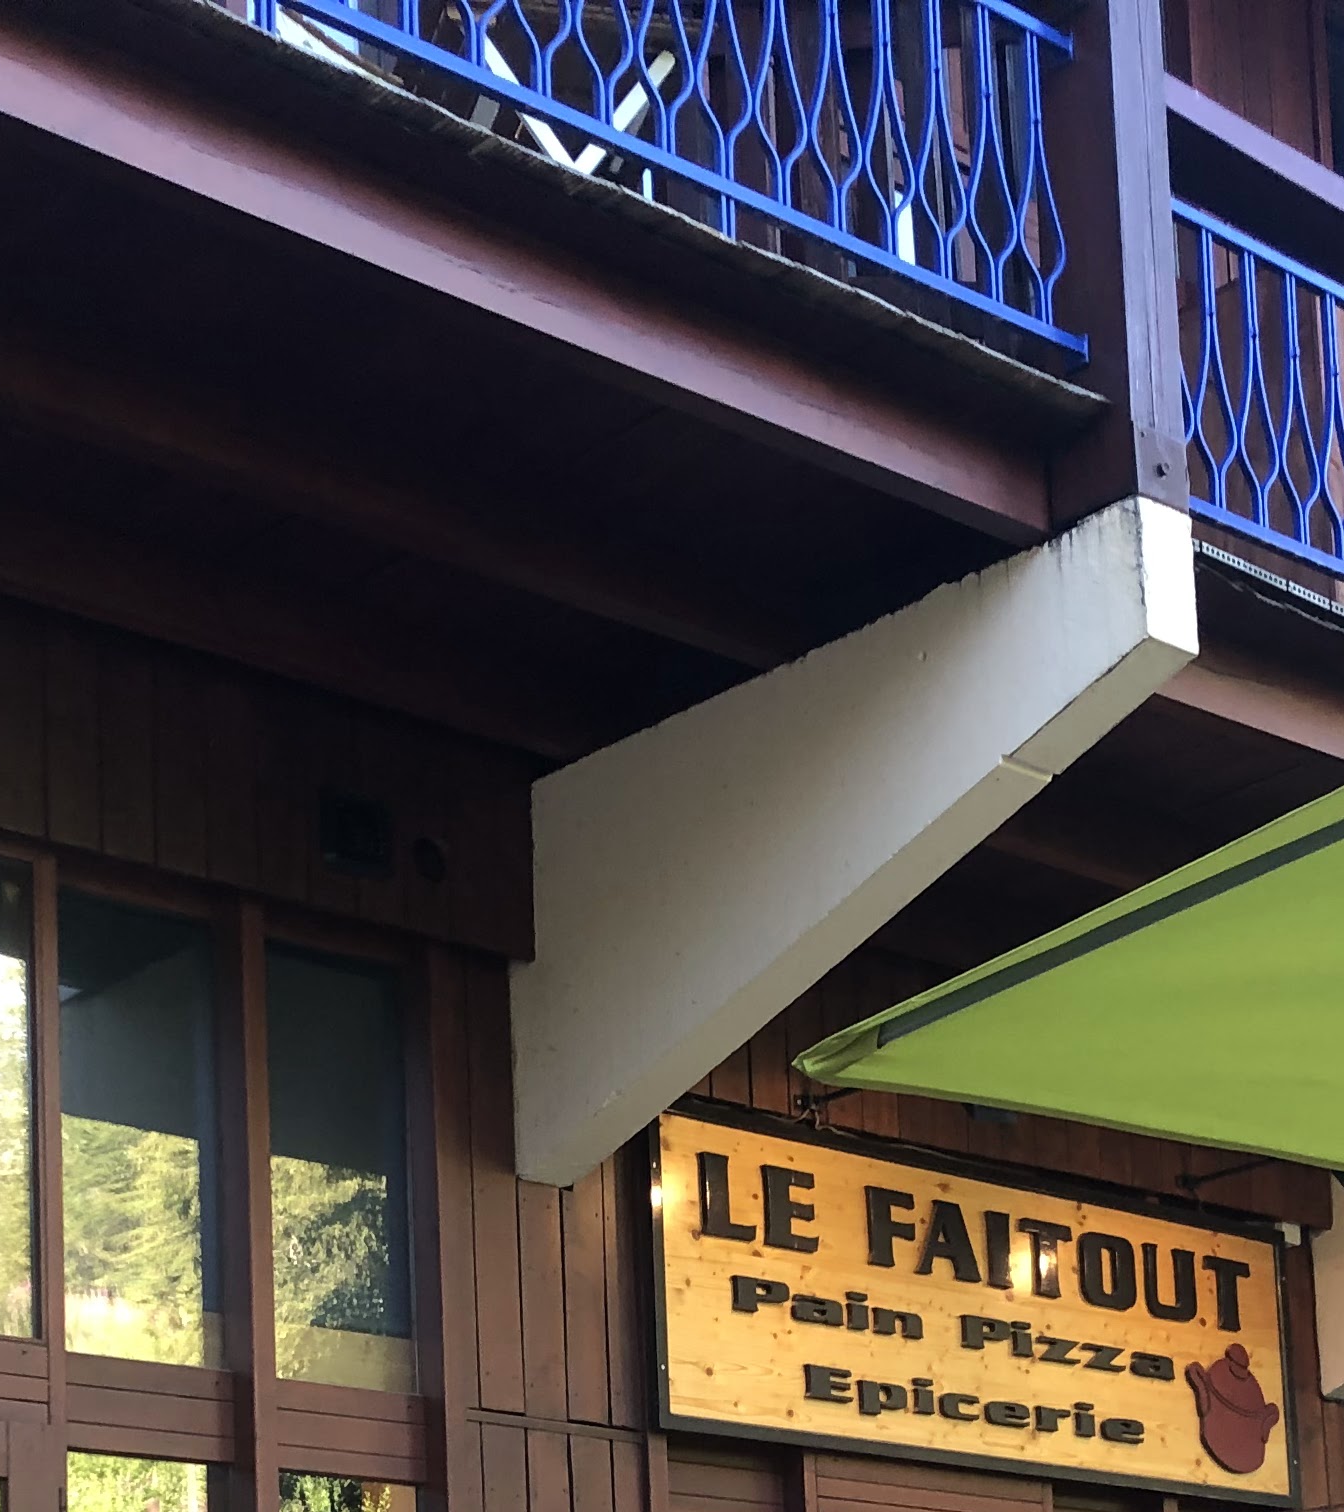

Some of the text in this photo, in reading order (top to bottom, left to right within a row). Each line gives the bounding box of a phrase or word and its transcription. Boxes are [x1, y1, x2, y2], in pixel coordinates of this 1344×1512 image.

[696, 1150, 1251, 1332] LE FAITOUT
[729, 1274, 1175, 1382] Pain Pizza
[803, 1363, 1145, 1444] Epicerie
